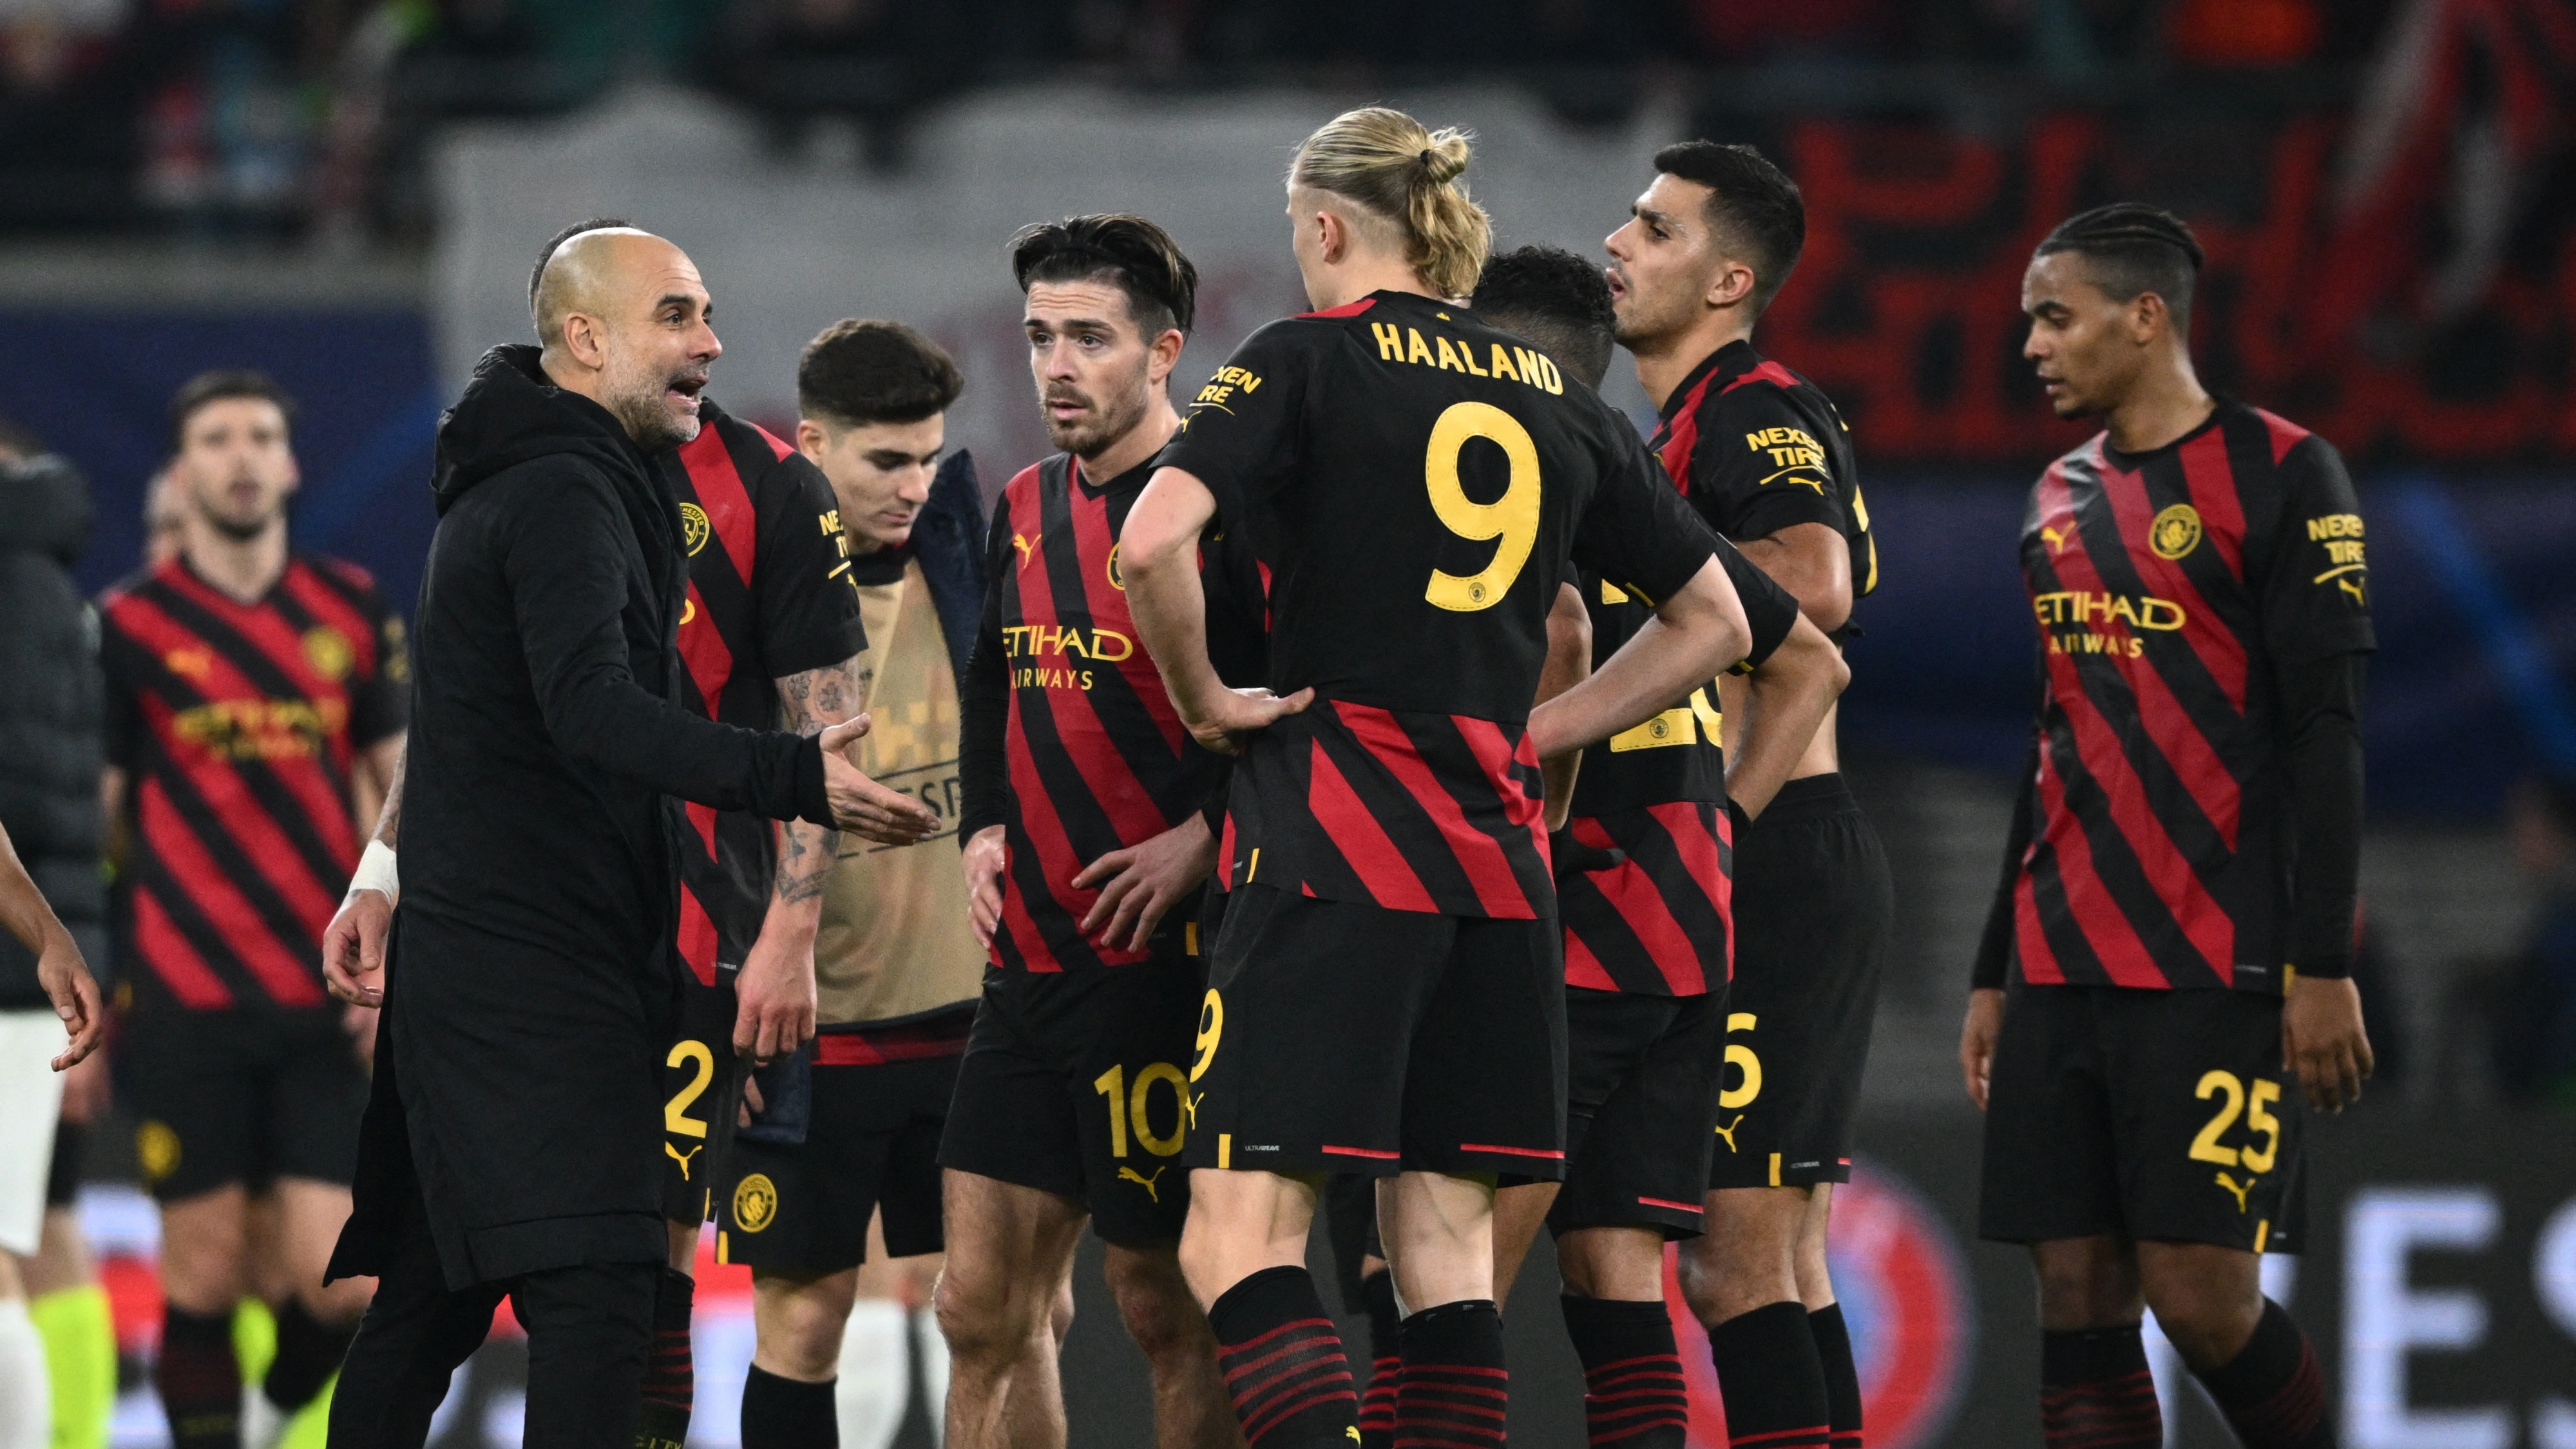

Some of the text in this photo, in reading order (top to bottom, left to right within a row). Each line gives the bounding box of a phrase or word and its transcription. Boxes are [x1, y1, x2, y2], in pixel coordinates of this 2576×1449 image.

[1371, 322, 1563, 395] HAALAND
[1746, 427, 1826, 458] NEXEN
[1767, 447, 1826, 473] TIRE
[819, 510, 844, 536] NE
[1425, 401, 1541, 611] 9
[2034, 591, 2186, 631] ETIHAD
[1002, 625, 1133, 662] ETIHAD
[2049, 633, 2144, 658] AIRWAS
[1011, 668, 1093, 690] AIRWAYS
[1190, 988, 1223, 1083] 9
[1719, 1012, 1762, 1108] 6
[664, 1039, 714, 1138] 2
[1094, 1062, 1188, 1157] 10
[2189, 1070, 2281, 1173] 25
